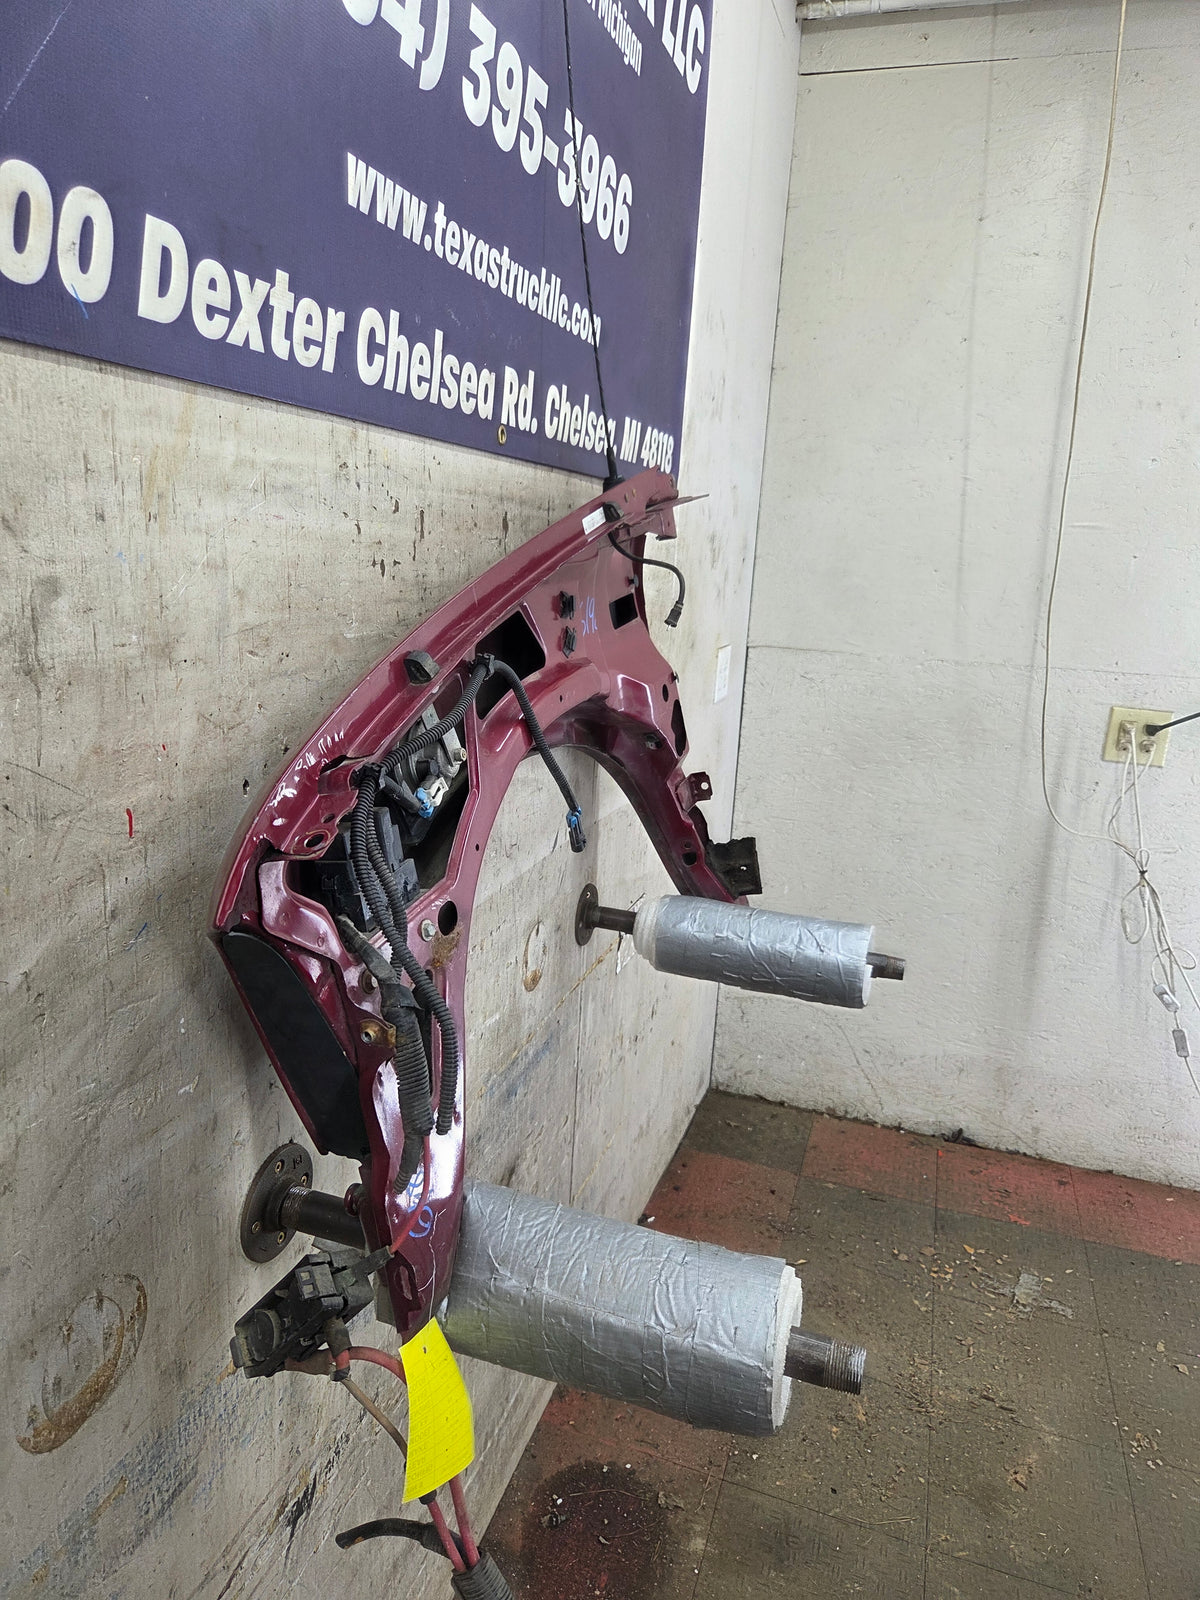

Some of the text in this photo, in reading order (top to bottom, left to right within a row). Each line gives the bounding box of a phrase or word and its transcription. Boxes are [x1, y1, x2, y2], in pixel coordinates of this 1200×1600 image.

[462, 2, 633, 255] 395-3966
[137, 213, 346, 374] Dexter
[356, 307, 496, 421] Chelsea
[501, 365, 538, 434] Rd.
[619, 416, 642, 465] MI
[640, 425, 675, 475] 48118
